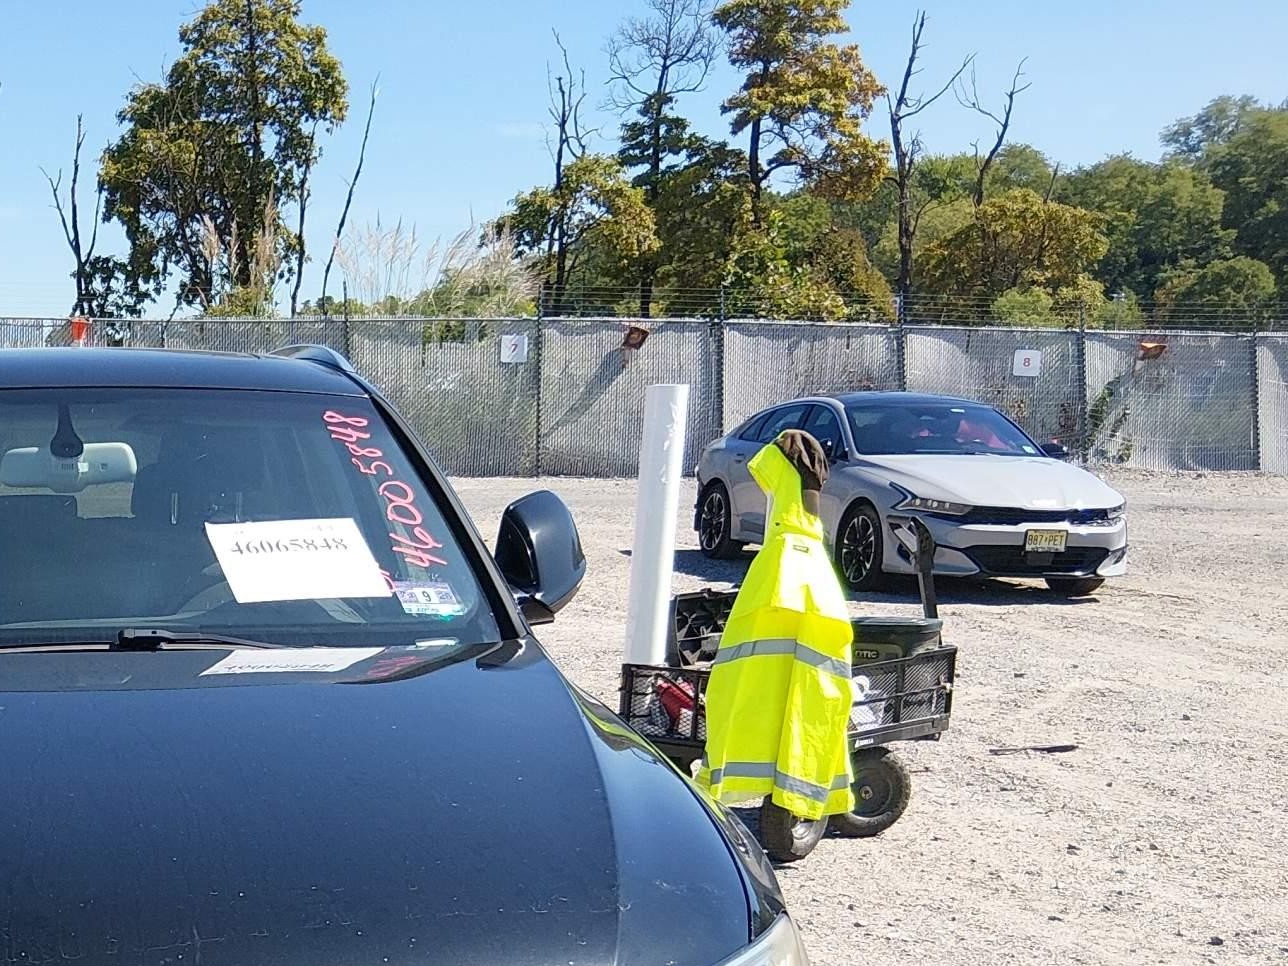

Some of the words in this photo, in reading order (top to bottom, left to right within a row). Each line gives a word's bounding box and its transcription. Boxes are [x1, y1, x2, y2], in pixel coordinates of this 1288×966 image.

[511, 343, 519, 354] 7
[1023, 357, 1031, 368] 8
[231, 536, 349, 555] 46065848
[422, 590, 432, 602] 9
